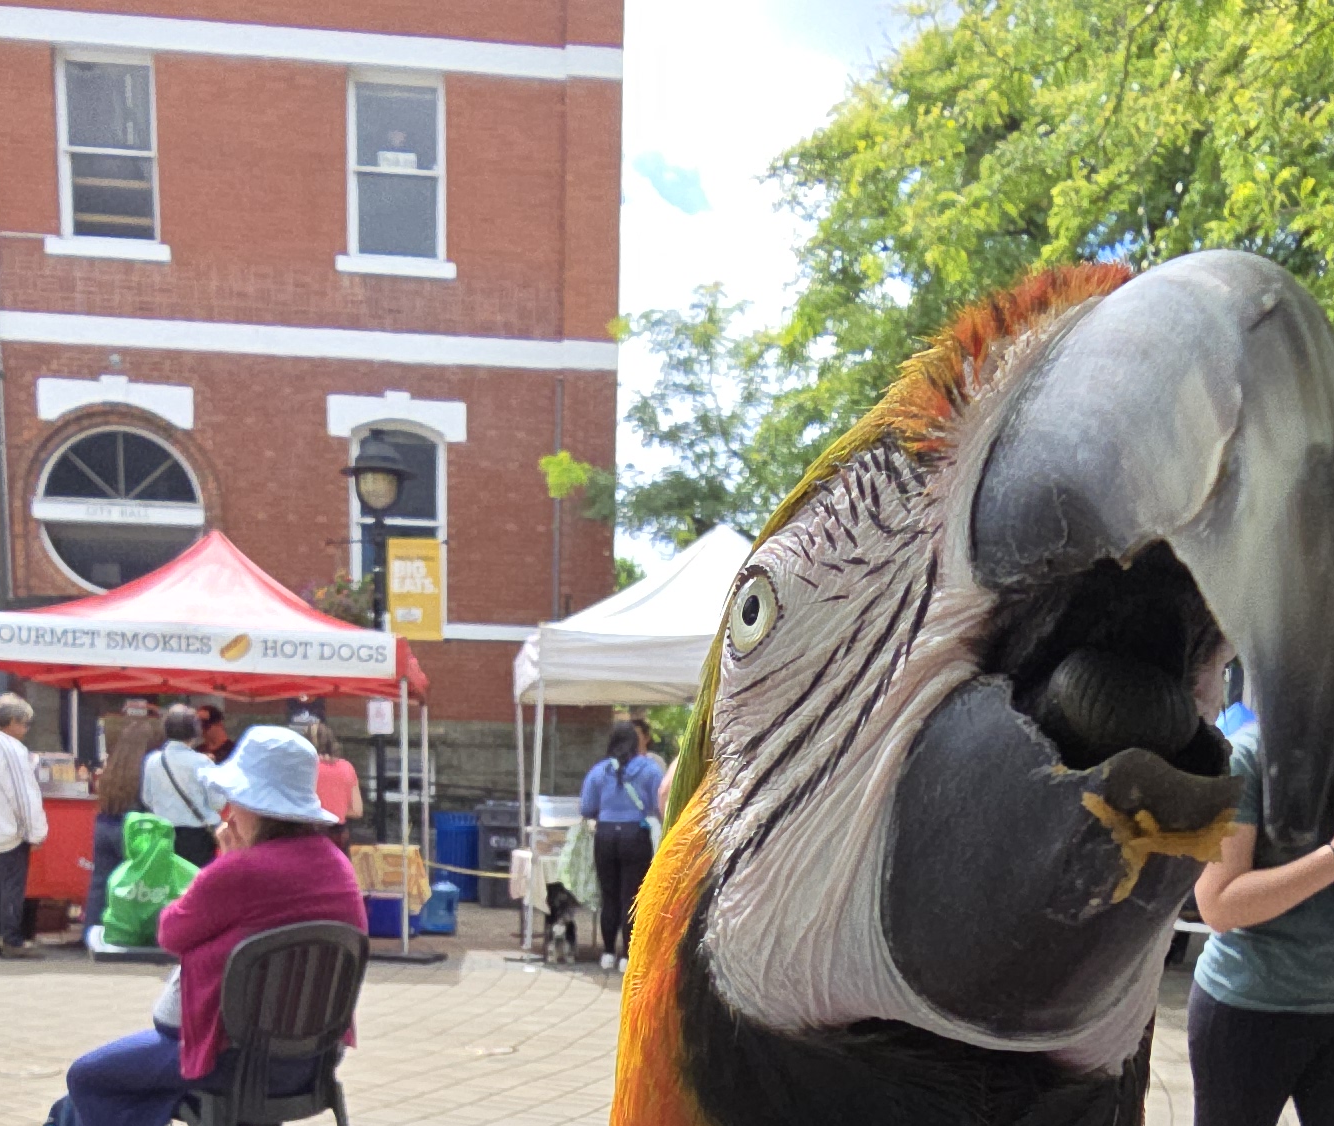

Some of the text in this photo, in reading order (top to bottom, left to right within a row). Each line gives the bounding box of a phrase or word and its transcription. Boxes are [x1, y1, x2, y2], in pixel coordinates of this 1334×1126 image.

[106, 631, 212, 654] SMOKIES
[261, 639, 313, 660] HOT
[319, 643, 387, 663] DOGS
